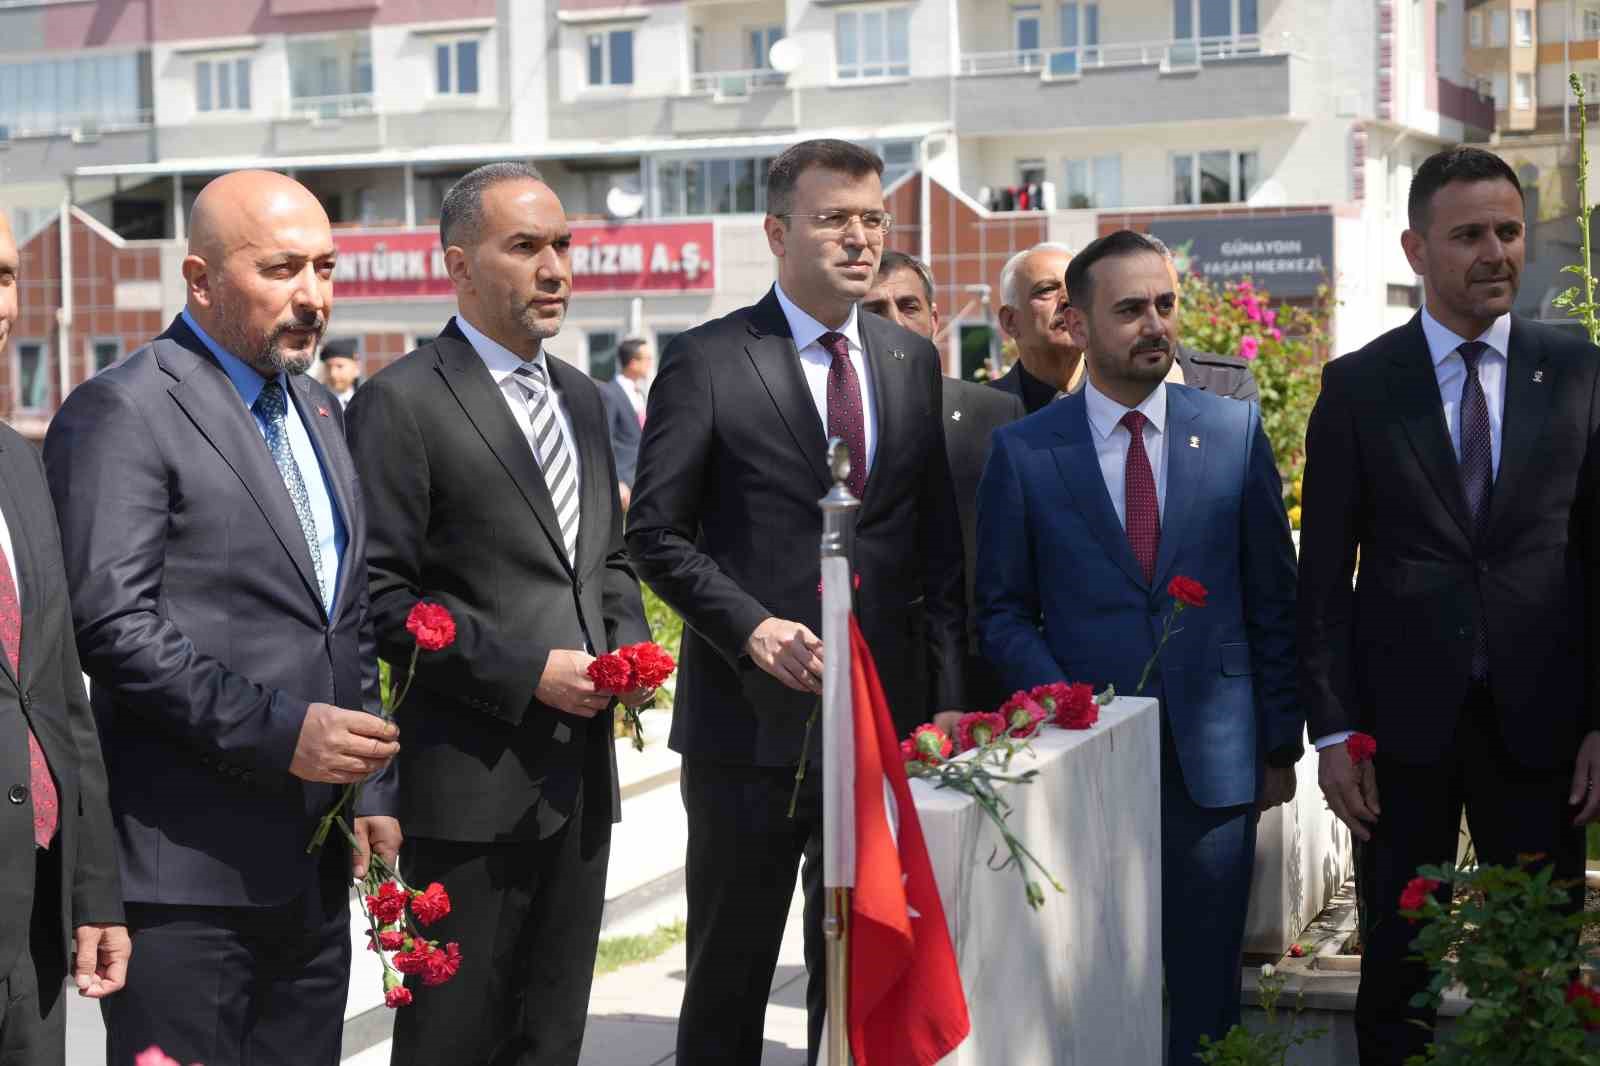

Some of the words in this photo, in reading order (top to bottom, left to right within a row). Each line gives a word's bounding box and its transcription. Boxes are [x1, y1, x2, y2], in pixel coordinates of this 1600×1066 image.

[1219, 238, 1302, 256] GÜNAYDIN
[335, 240, 426, 281] NTÜRK
[571, 236, 643, 275] RİZM
[650, 241, 711, 281] A.Ş.
[1203, 260, 1253, 276] YAŞAM
